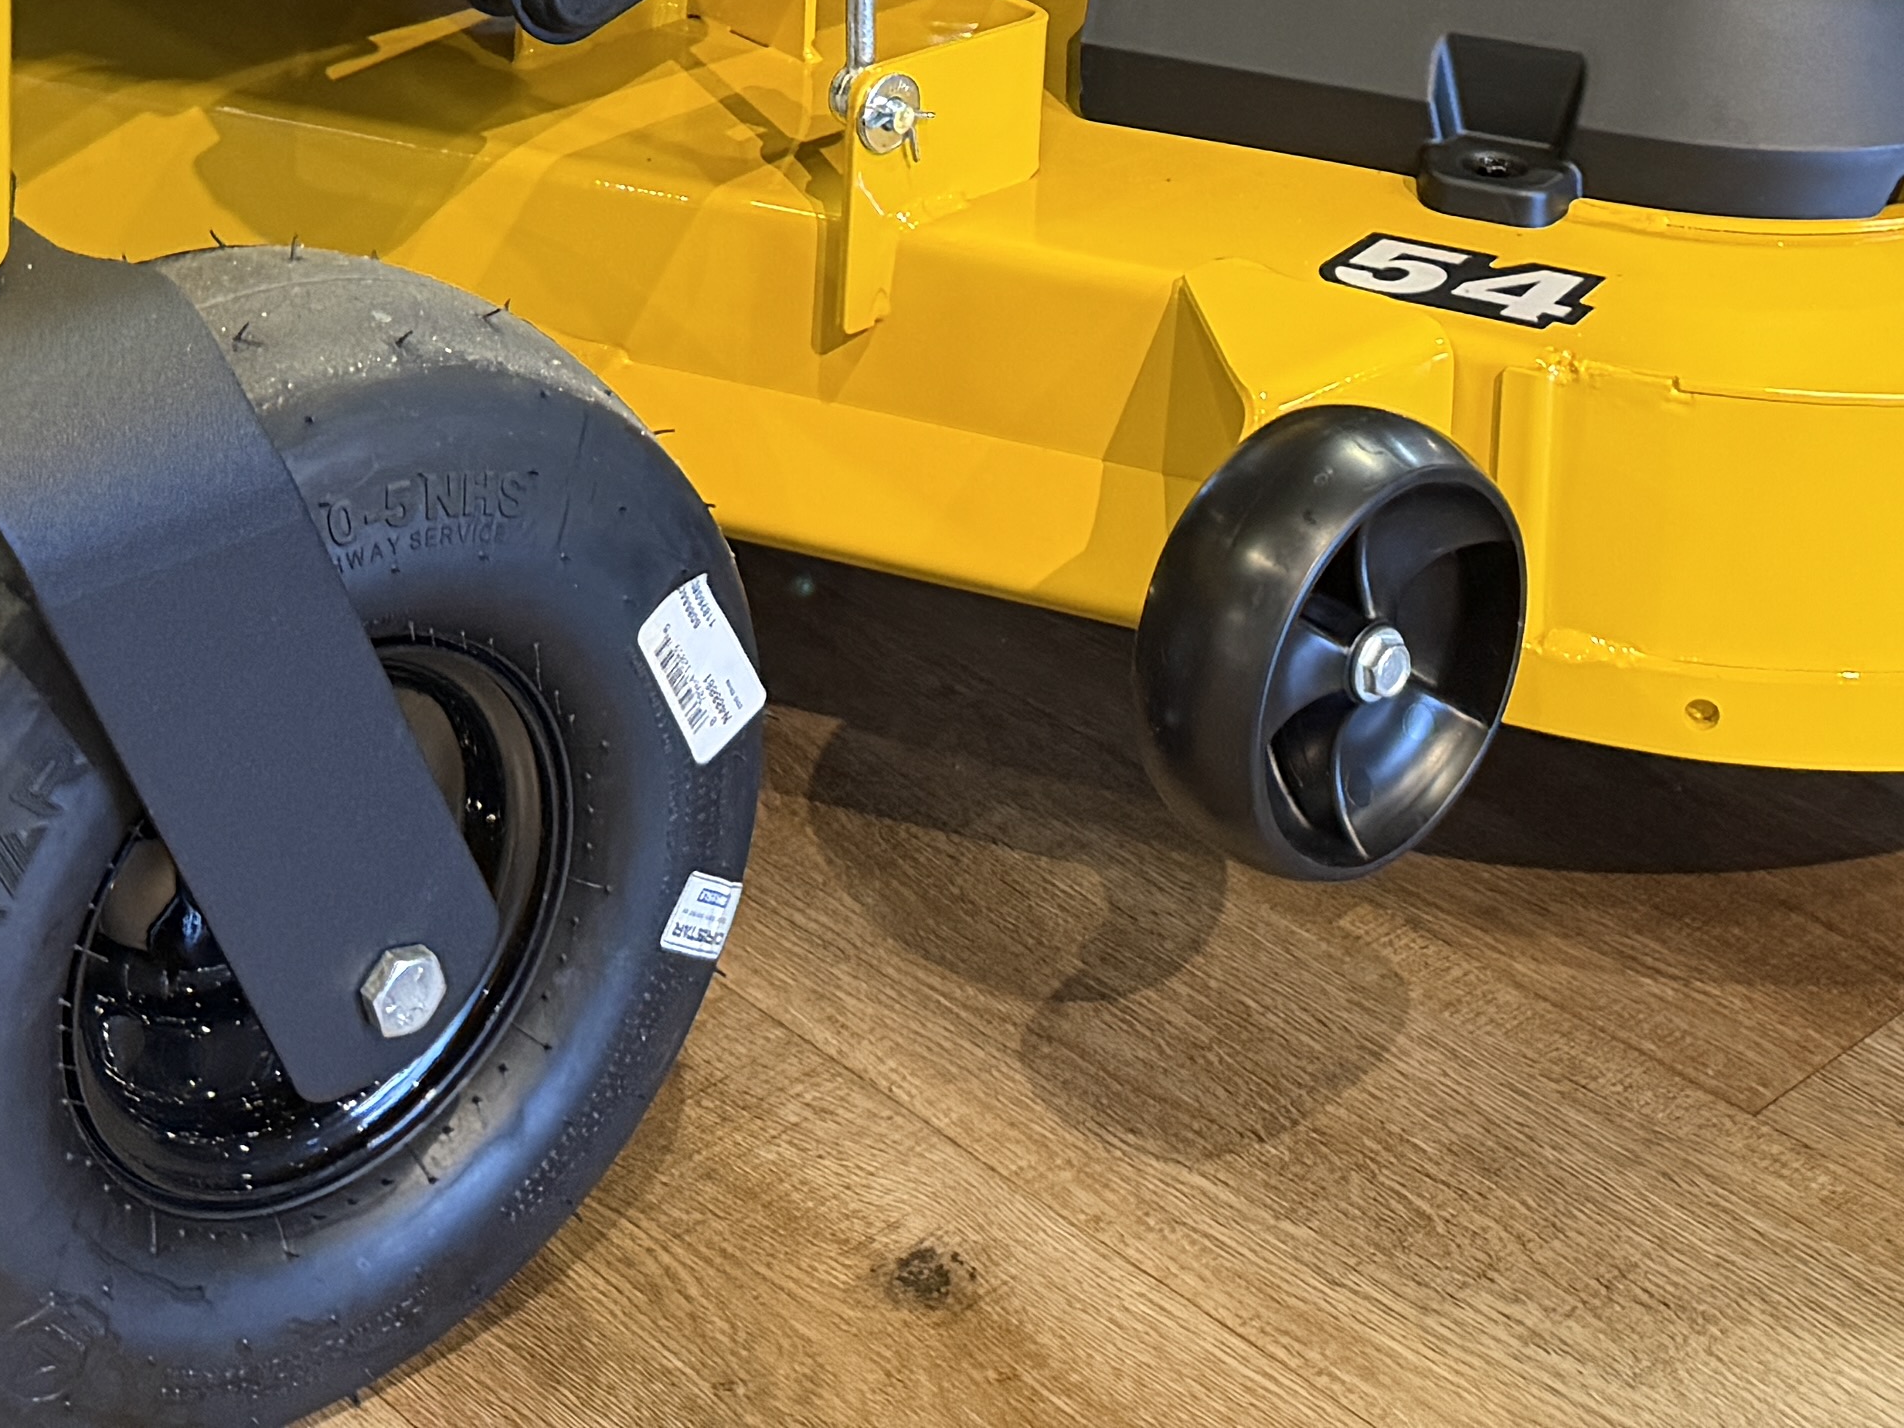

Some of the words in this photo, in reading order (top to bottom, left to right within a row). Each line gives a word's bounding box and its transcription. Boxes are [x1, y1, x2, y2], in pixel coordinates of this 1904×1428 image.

[1334, 237, 1585, 323] 54
[415, 469, 529, 522] NHS
[409, 520, 508, 552] SERVICE
